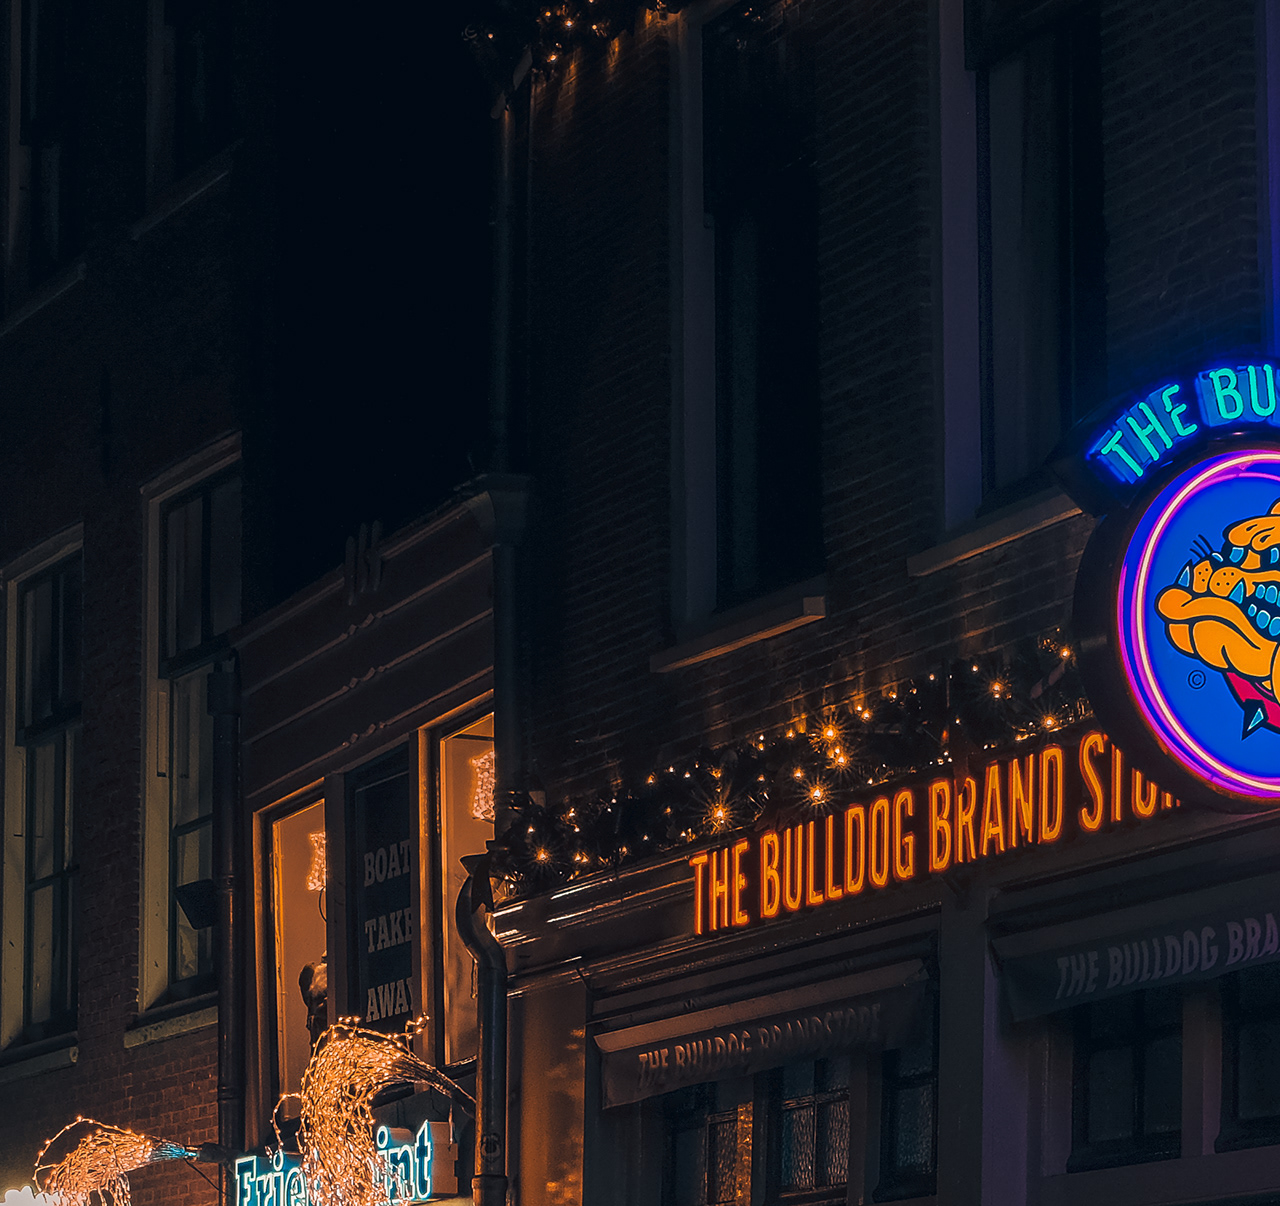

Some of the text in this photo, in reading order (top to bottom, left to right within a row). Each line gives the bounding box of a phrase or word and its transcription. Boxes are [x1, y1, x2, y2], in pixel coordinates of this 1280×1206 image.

[1101, 384, 1197, 478] THE
[364, 839, 411, 887] BOAT
[689, 838, 749, 936] THE
[760, 788, 917, 919] BULLDOG
[928, 743, 1064, 873] BRAND
[1055, 950, 1099, 1000] THE
[1106, 925, 1219, 989] BULLDOG
